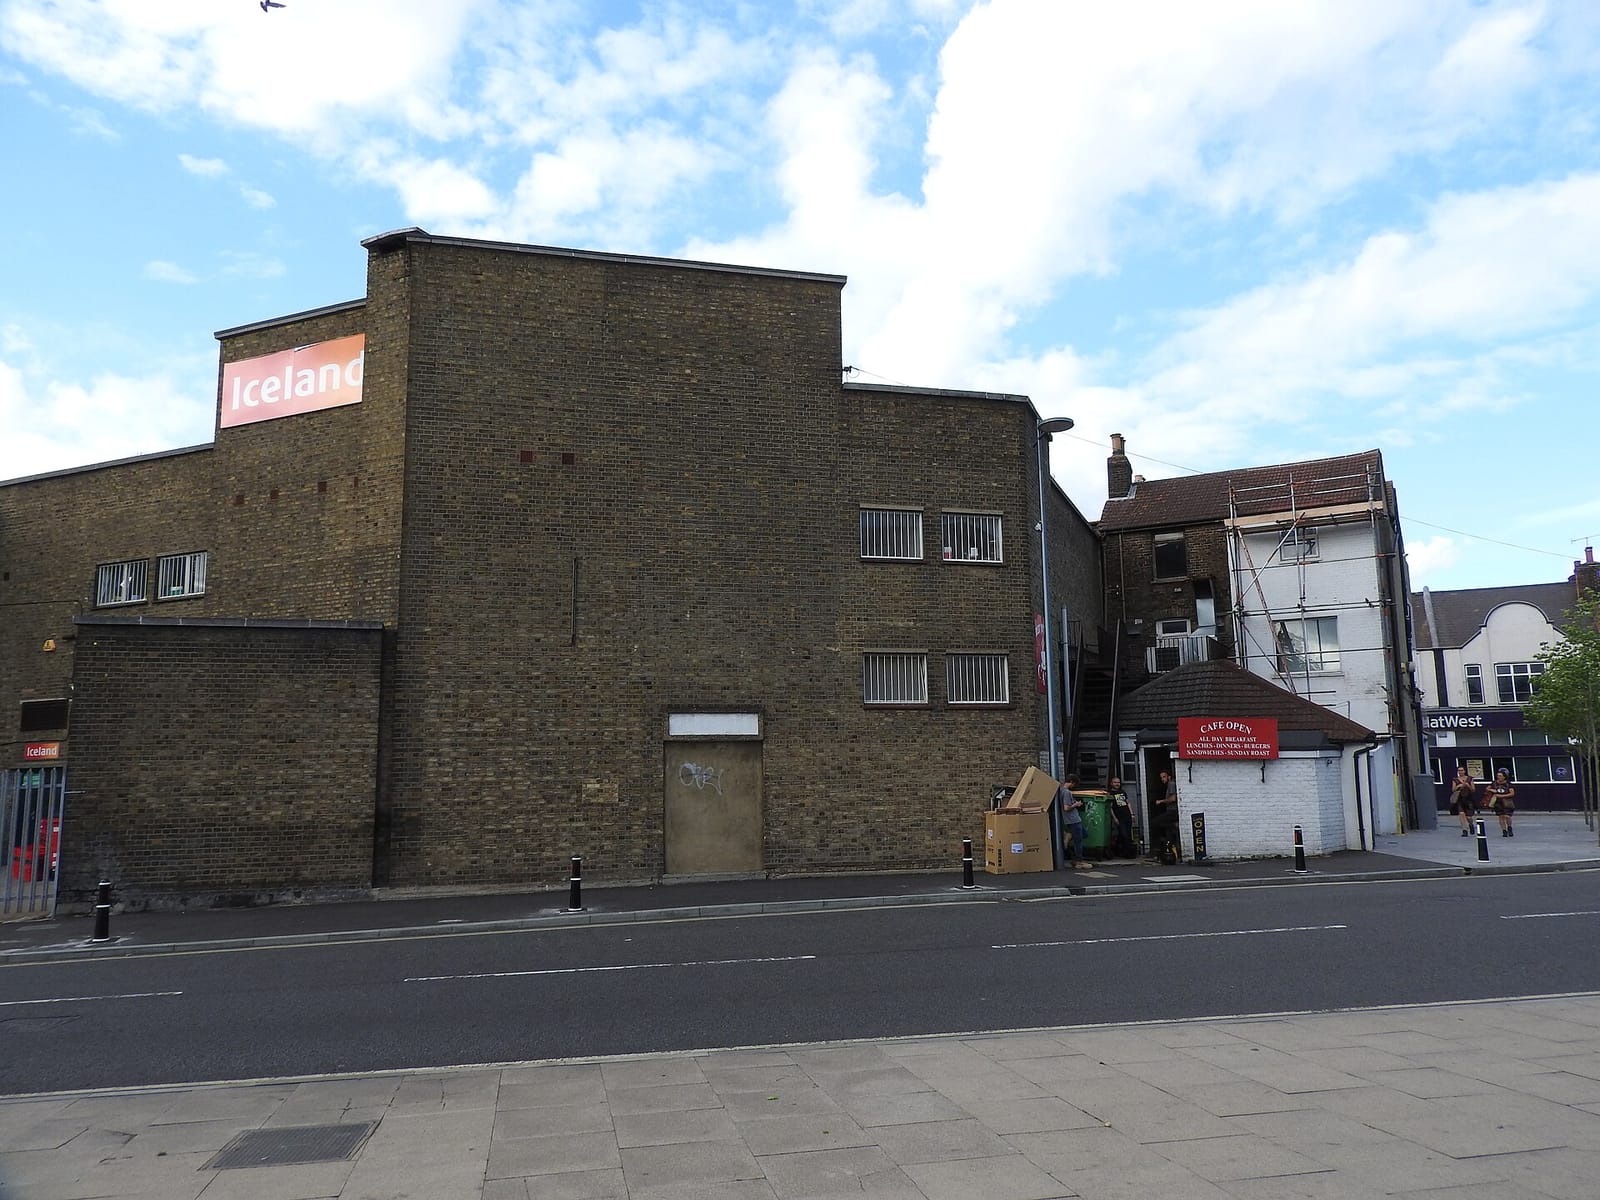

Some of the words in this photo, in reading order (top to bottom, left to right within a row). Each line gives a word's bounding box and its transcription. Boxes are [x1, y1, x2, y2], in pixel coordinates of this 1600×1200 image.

[231, 350, 365, 411] Iceland
[1200, 721, 1224, 734] CAFE
[1226, 721, 1252, 735] OPEN
[1427, 715, 1483, 728] atWest
[26, 746, 57, 757] Iceland
[1194, 820, 1204, 852] OPEN
